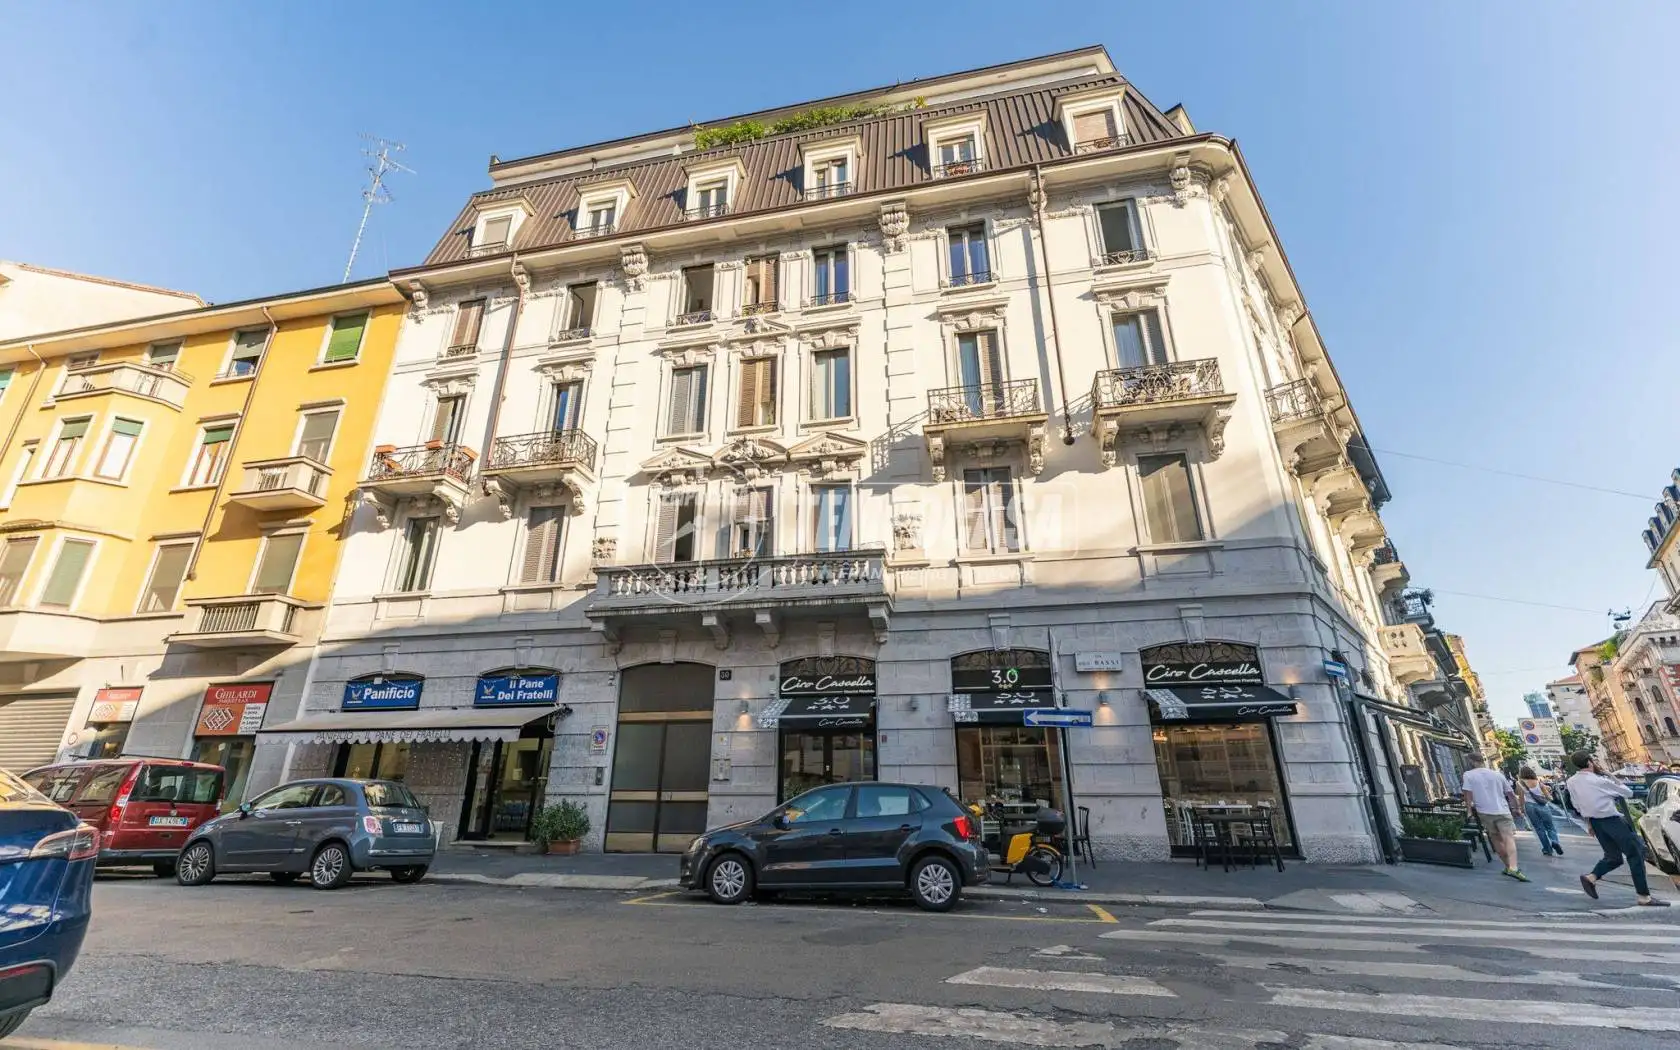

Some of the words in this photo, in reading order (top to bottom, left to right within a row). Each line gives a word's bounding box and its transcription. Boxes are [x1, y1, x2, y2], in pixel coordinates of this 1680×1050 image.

[991, 669, 1018, 684] 3.0
[1146, 664, 1186, 680] Ciro
[1188, 663, 1260, 680] Cascella
[518, 679, 544, 689] Pane
[781, 677, 814, 691] Ciro
[815, 675, 874, 691] Cascella
[363, 686, 415, 700] Panificio
[516, 689, 553, 700] Fratelli
